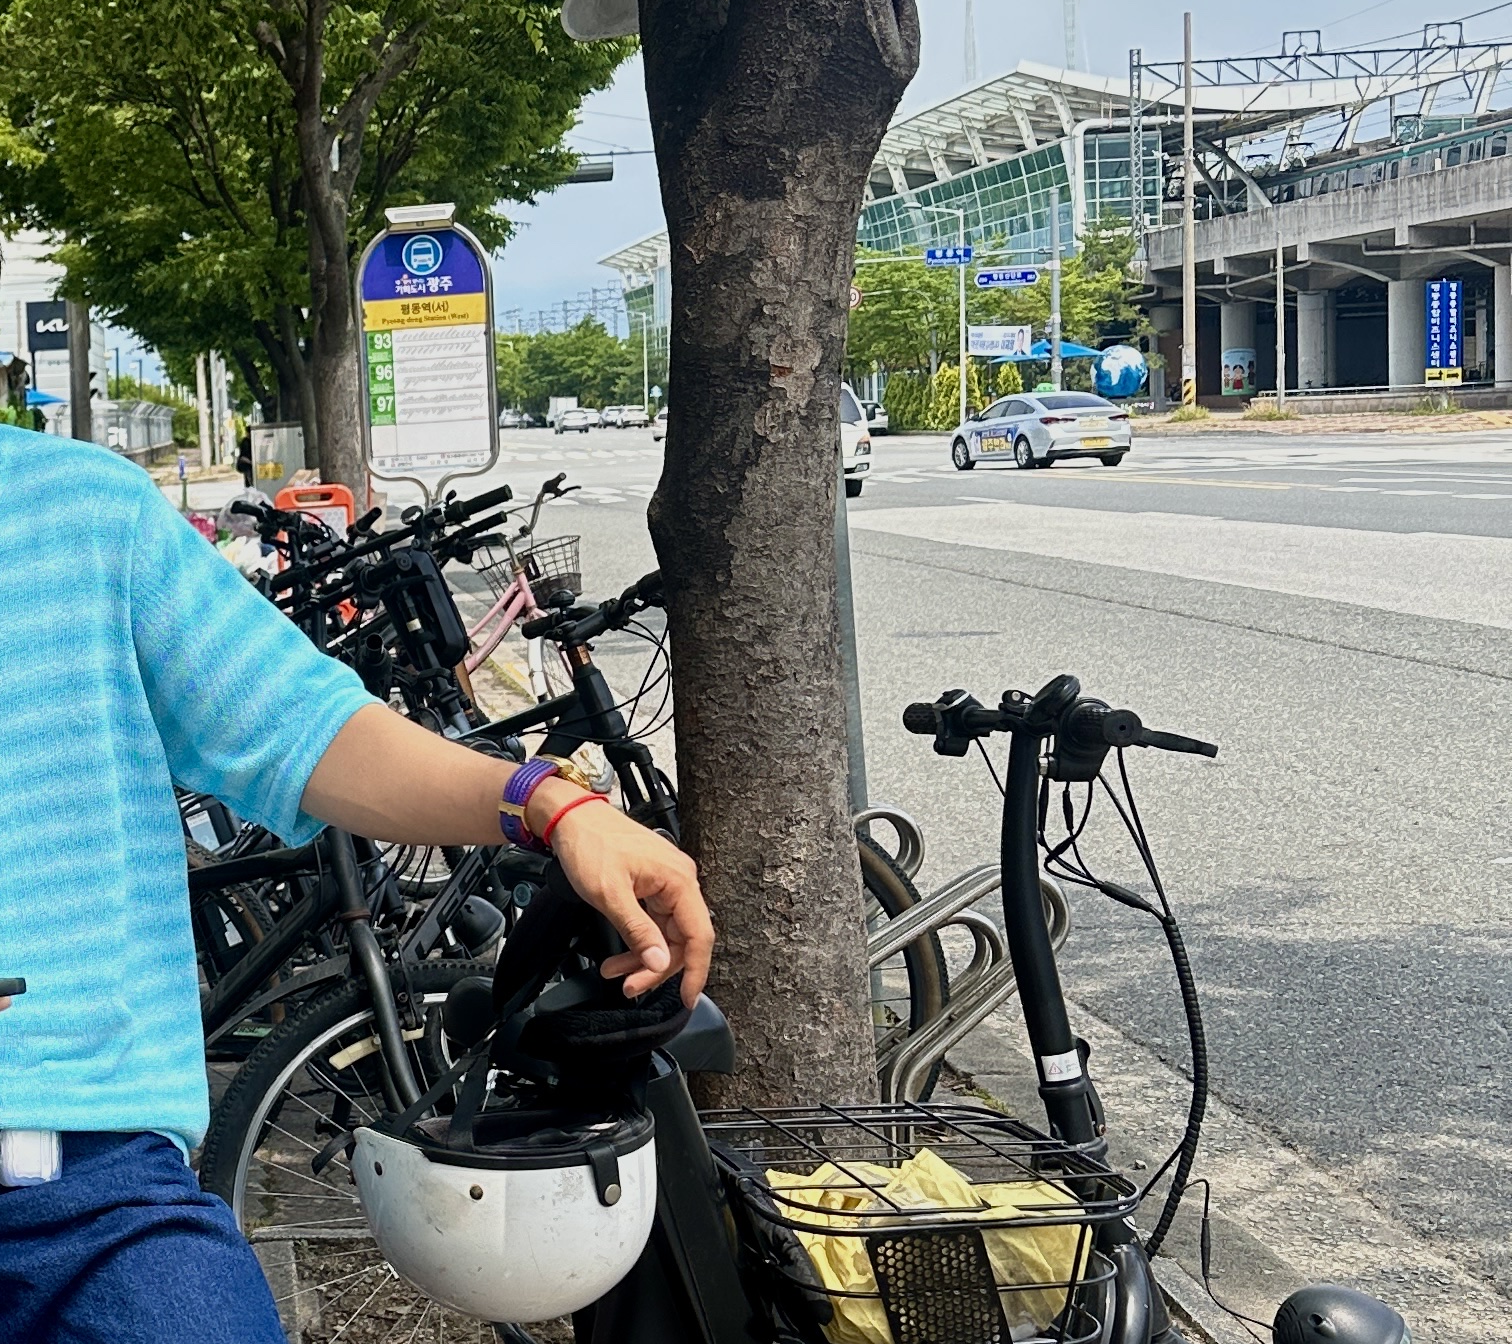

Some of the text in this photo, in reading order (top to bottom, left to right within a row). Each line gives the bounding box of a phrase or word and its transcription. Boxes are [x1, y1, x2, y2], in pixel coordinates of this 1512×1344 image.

[426, 276, 453, 292] 광주
[400, 300, 450, 316] 평동역(서)
[373, 333, 392, 350] 93
[375, 364, 393, 381] 96
[376, 396, 394, 412] 97
